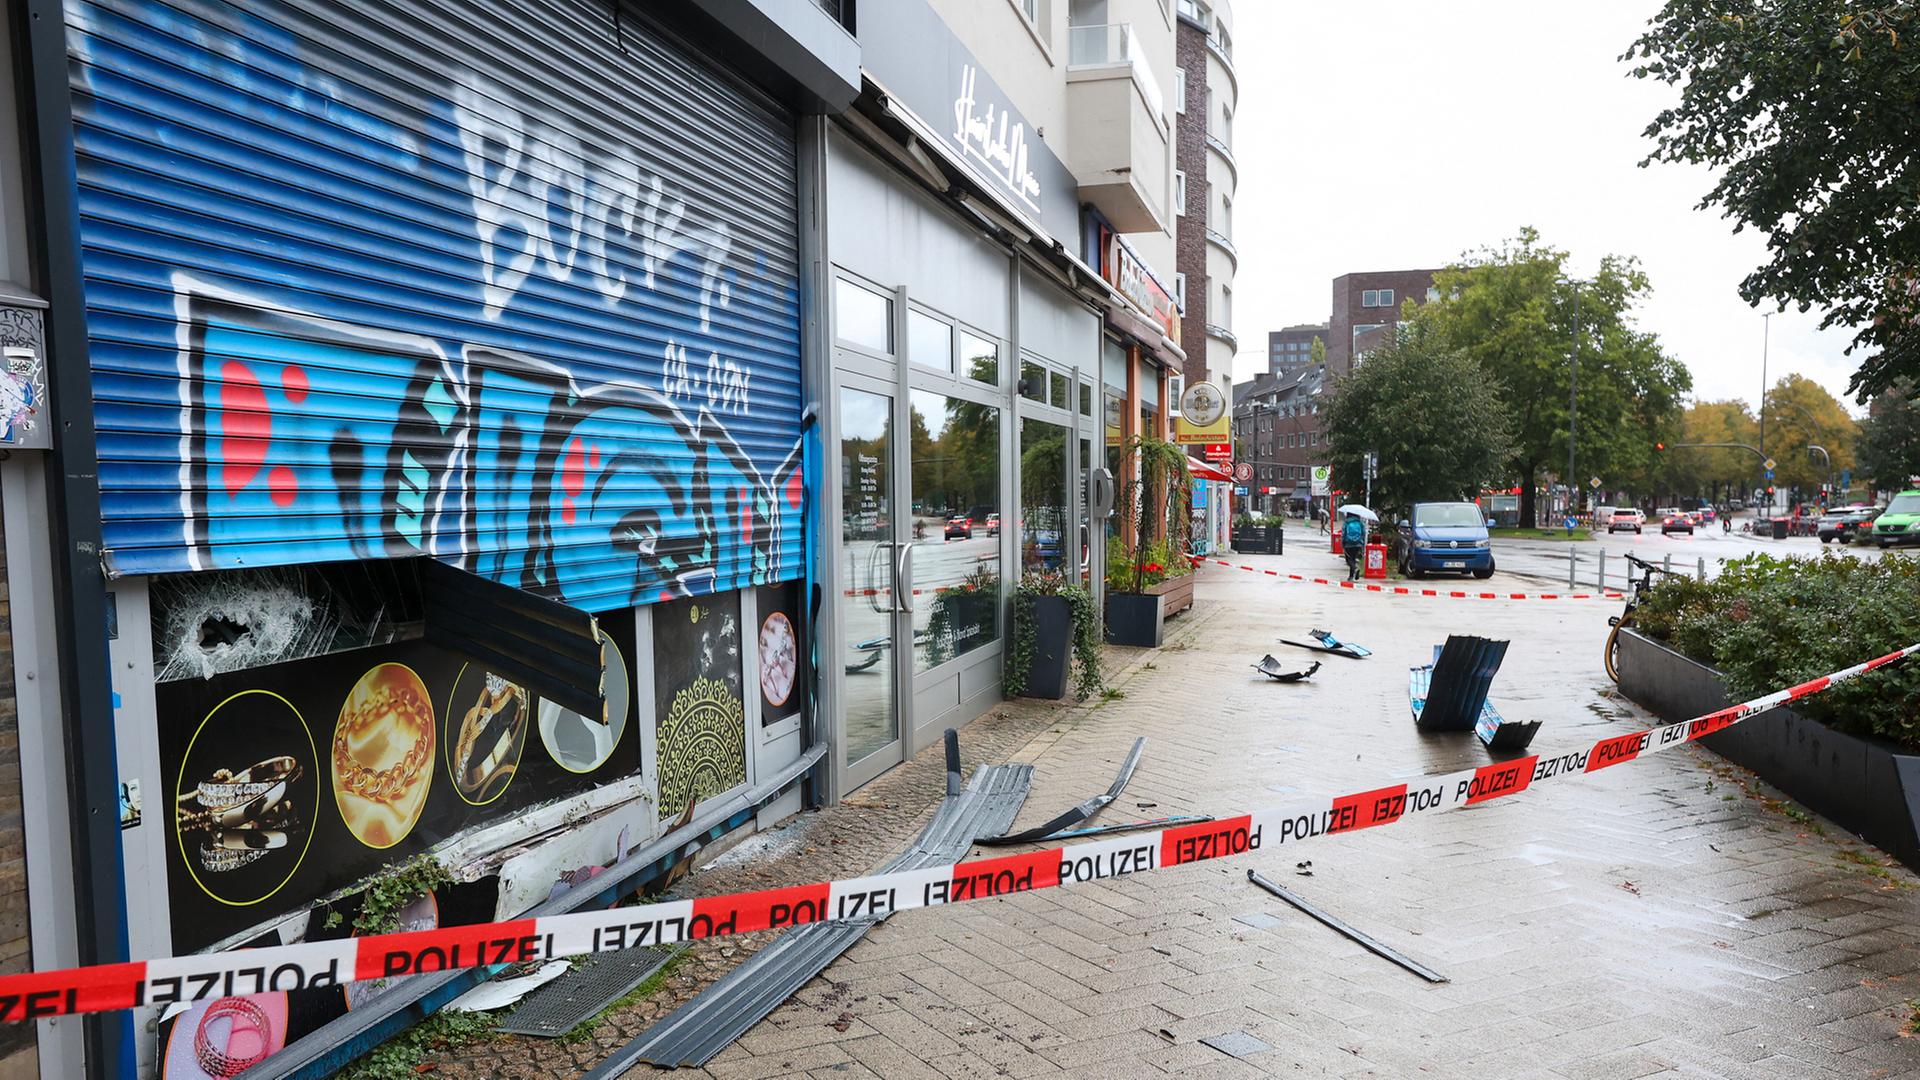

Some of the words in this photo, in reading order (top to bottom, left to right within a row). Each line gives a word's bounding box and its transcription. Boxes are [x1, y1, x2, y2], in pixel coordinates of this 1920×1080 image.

[384, 933, 554, 977] POLIZEI
[770, 888, 896, 928] POLIZEI
[923, 866, 1033, 906] POLIZEI
[1058, 845, 1155, 885] POLIZEI
[1176, 824, 1262, 865] POLIZEI
[1280, 804, 1358, 844] POLIZEI
[1372, 785, 1443, 823] POLIZEI
[1454, 766, 1520, 802] POLIZEI
[1530, 749, 1590, 782] POLIZEI
[1598, 731, 1653, 764] POLIZEI
